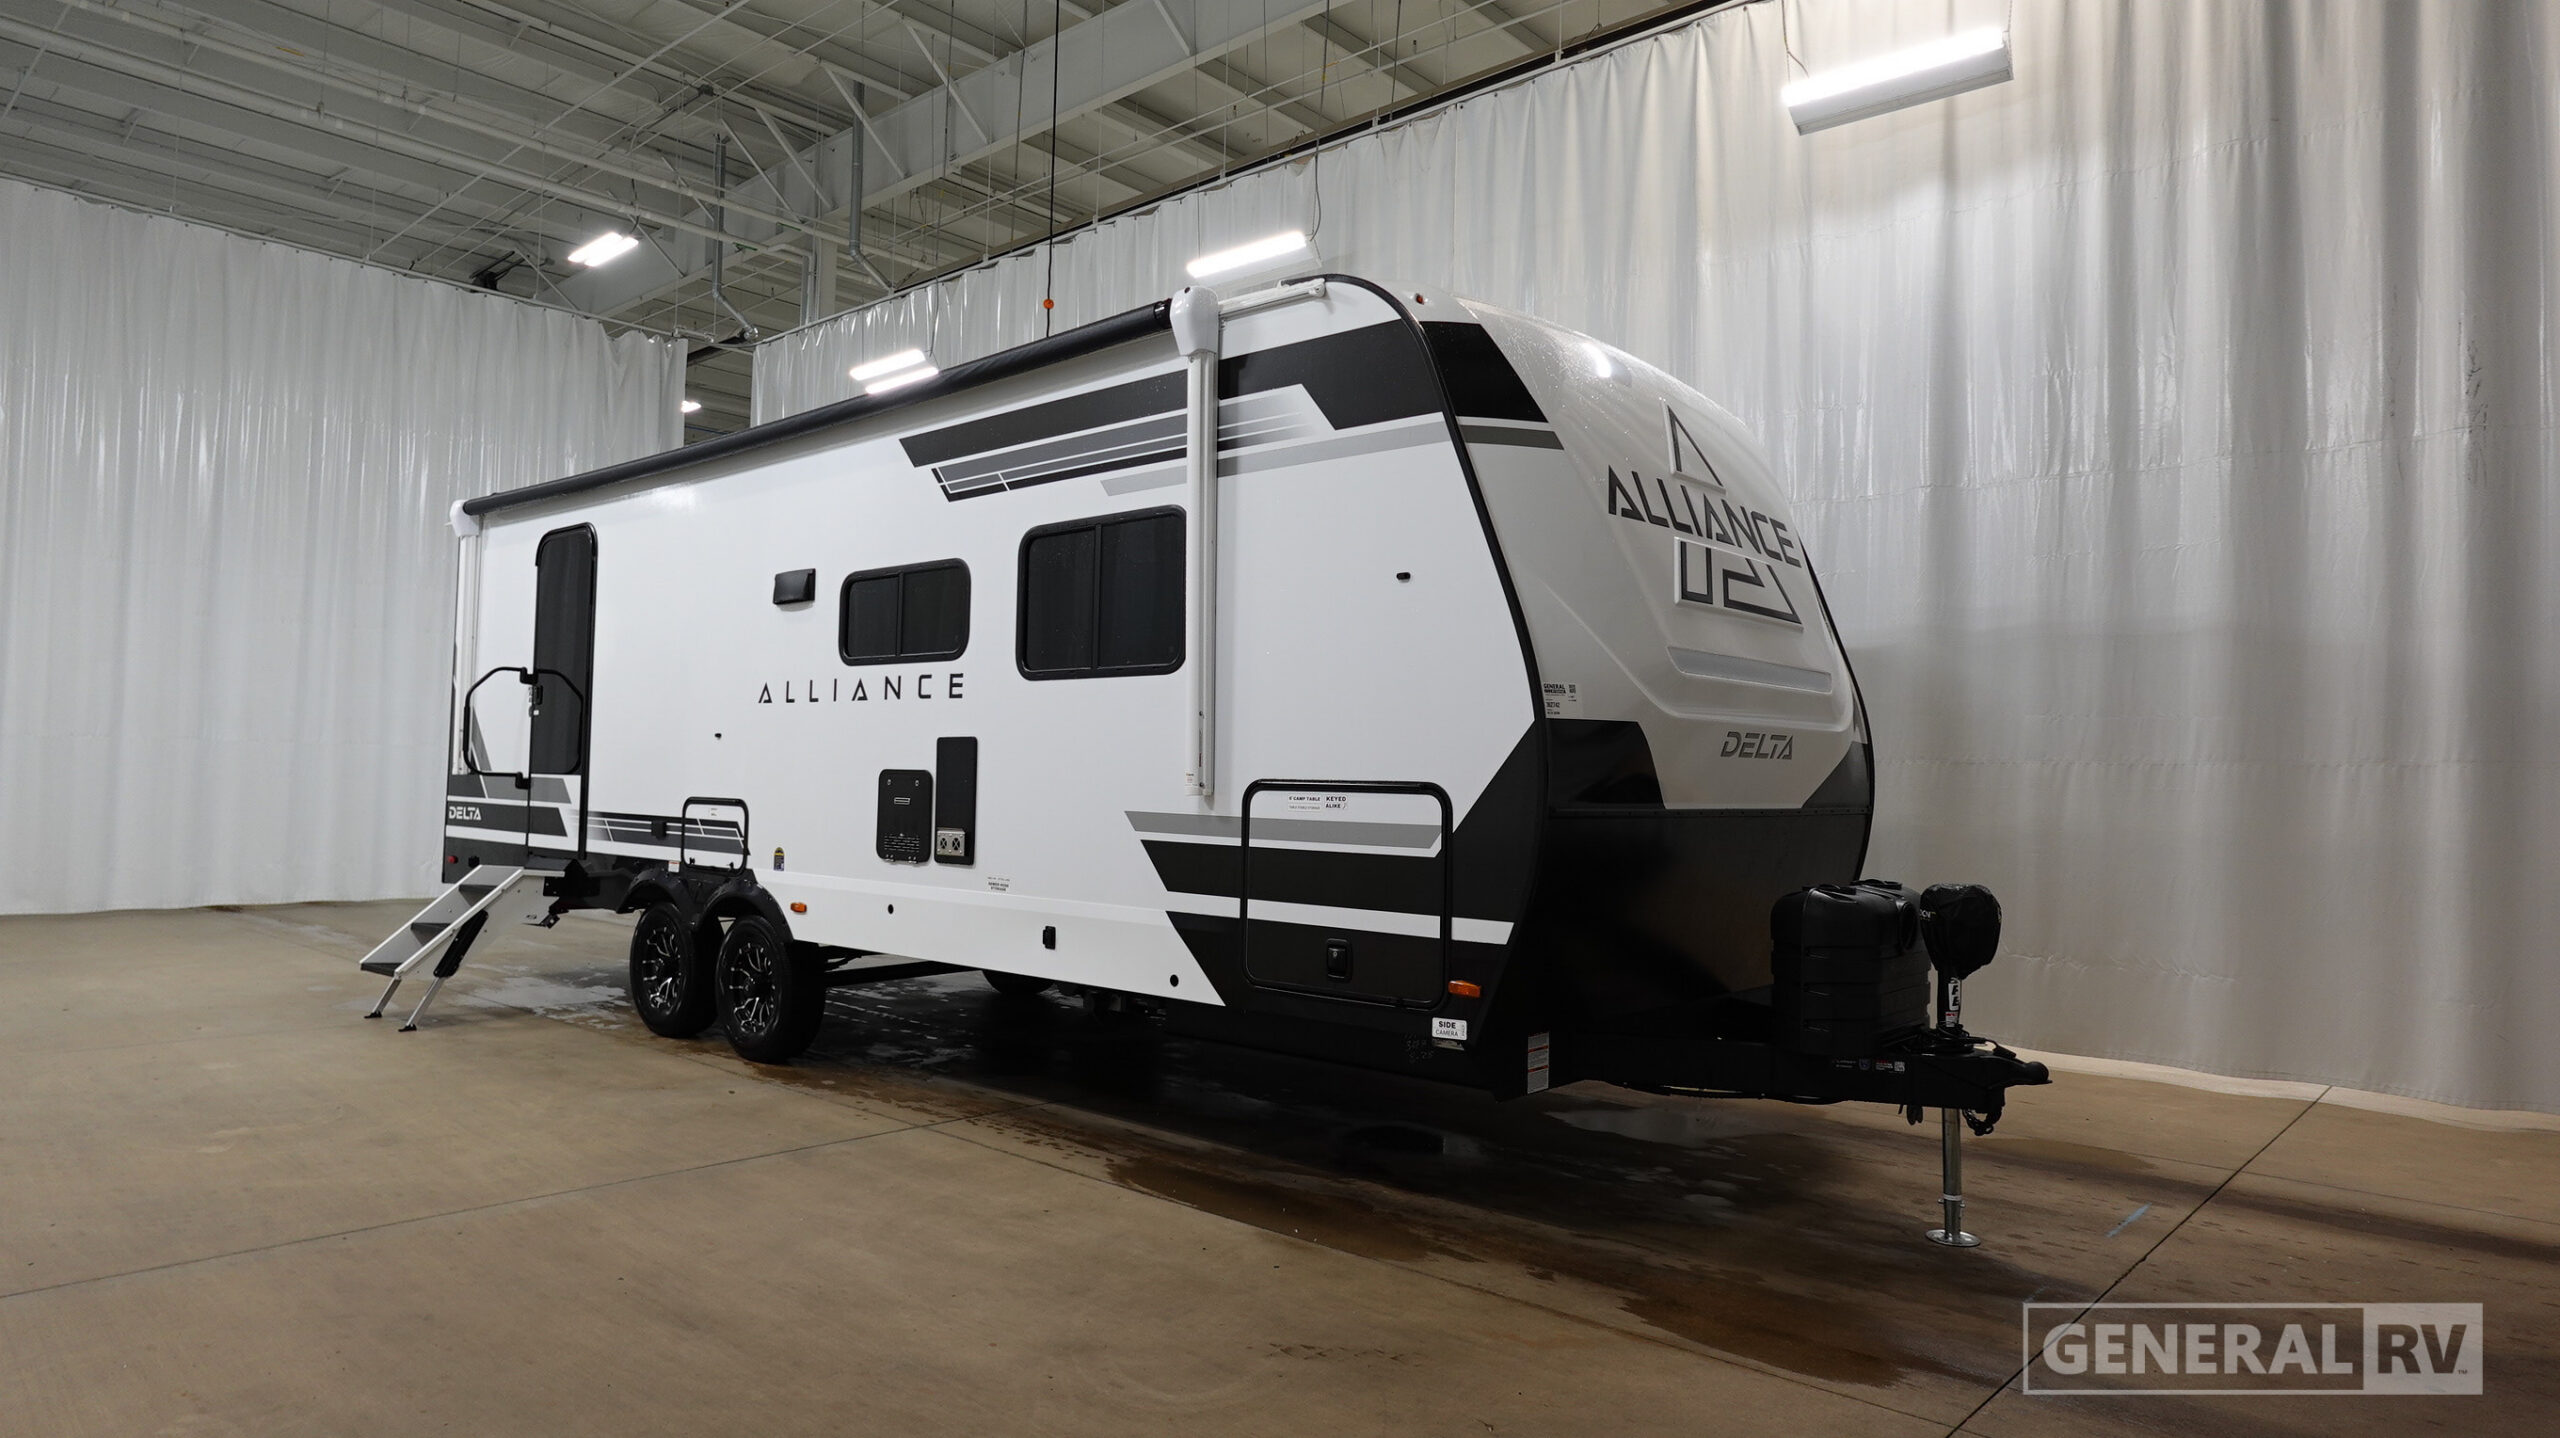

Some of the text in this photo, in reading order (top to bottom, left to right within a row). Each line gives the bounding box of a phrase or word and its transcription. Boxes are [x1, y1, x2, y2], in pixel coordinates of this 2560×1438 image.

[1608, 464, 1802, 568] ALLIANCE
[758, 672, 964, 704] ALLIANCE
[1720, 731, 1794, 760] DELTA
[448, 806, 482, 821] DELTA
[1435, 1029, 1459, 1037] CAMERA
[1438, 1020, 1456, 1029] SIDE
